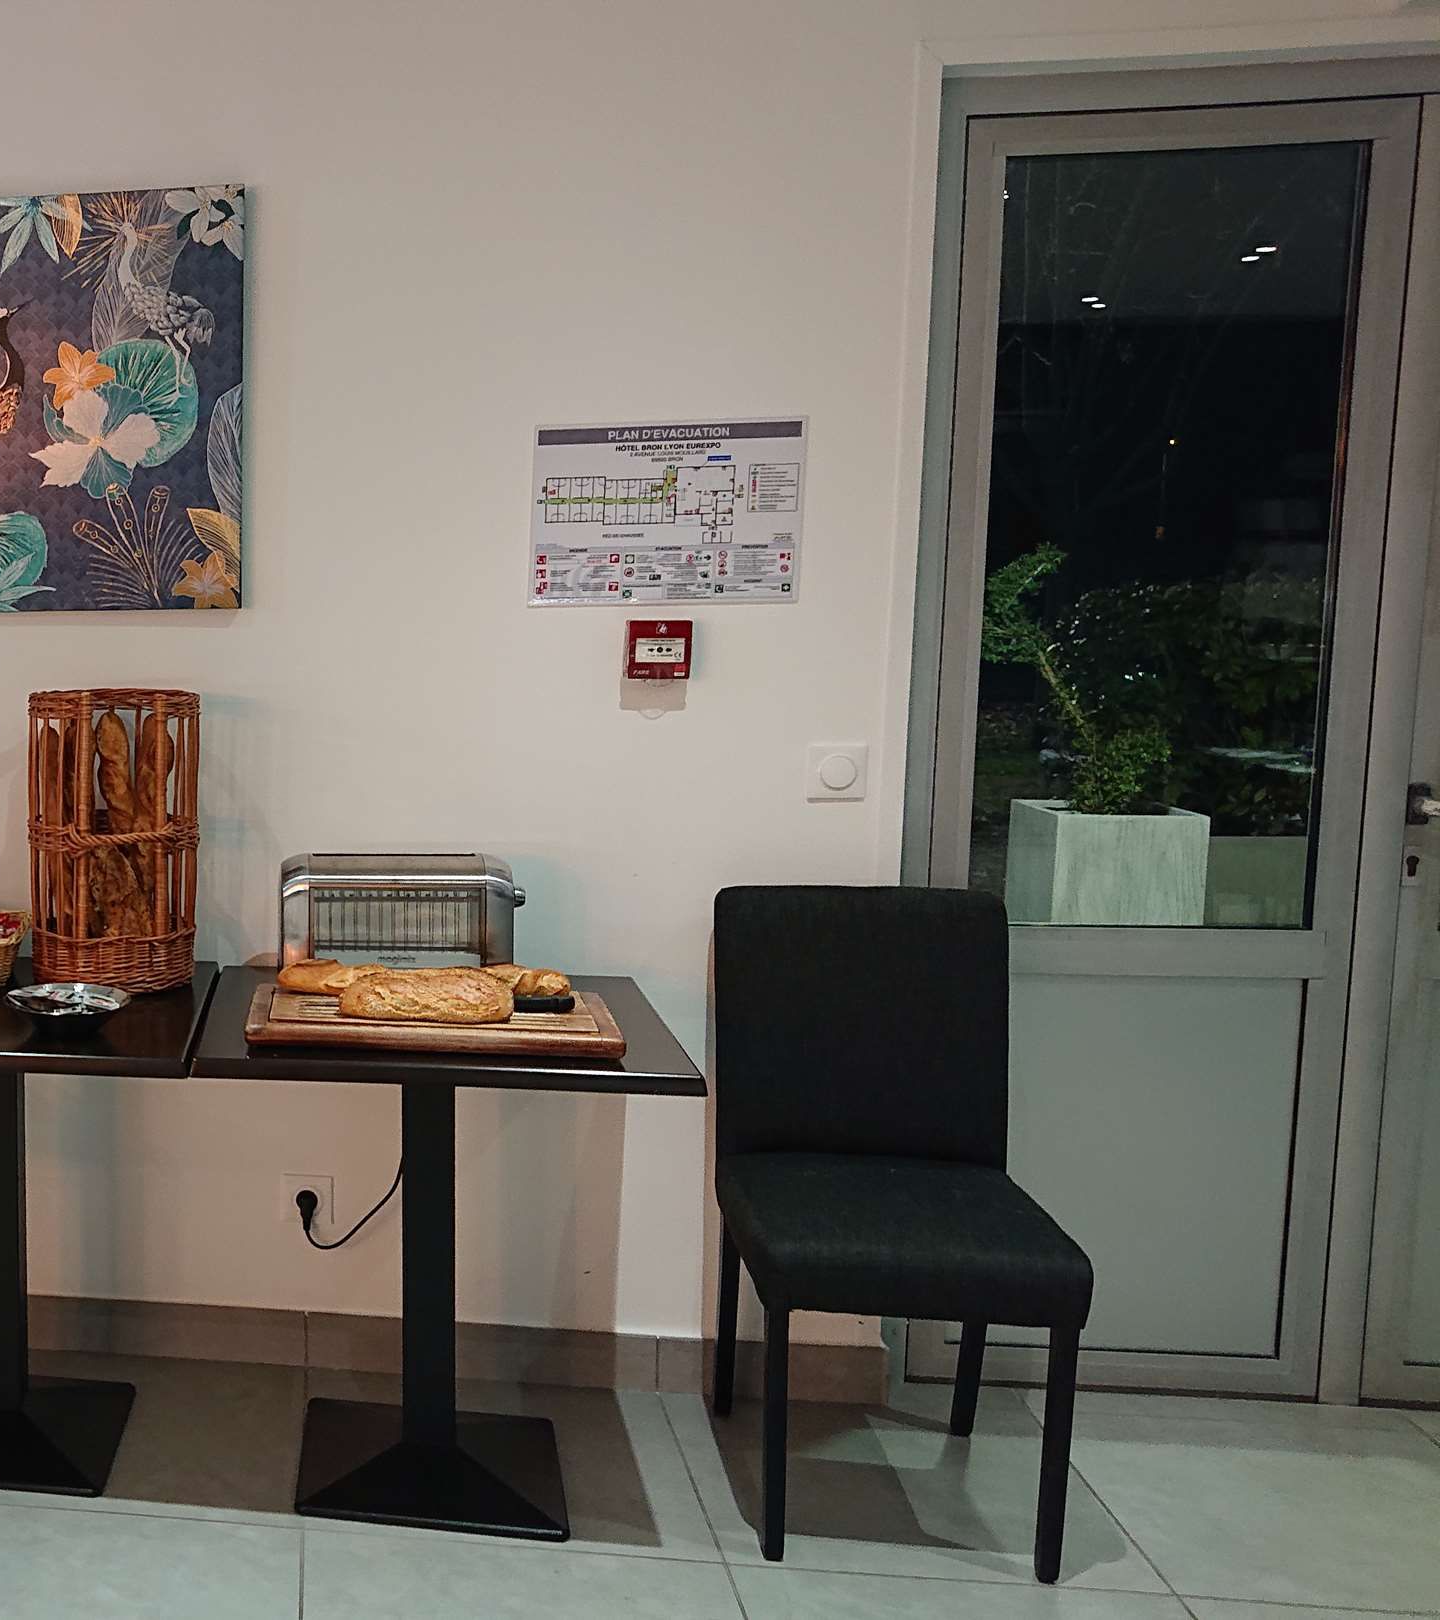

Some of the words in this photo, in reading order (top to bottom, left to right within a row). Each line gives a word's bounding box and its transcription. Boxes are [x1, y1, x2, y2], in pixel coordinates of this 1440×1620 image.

[608, 430, 639, 440] PLAN
[642, 427, 730, 439] D'EVACUATION
[641, 443, 663, 451] BRON
[686, 441, 721, 450] EUREXPO
